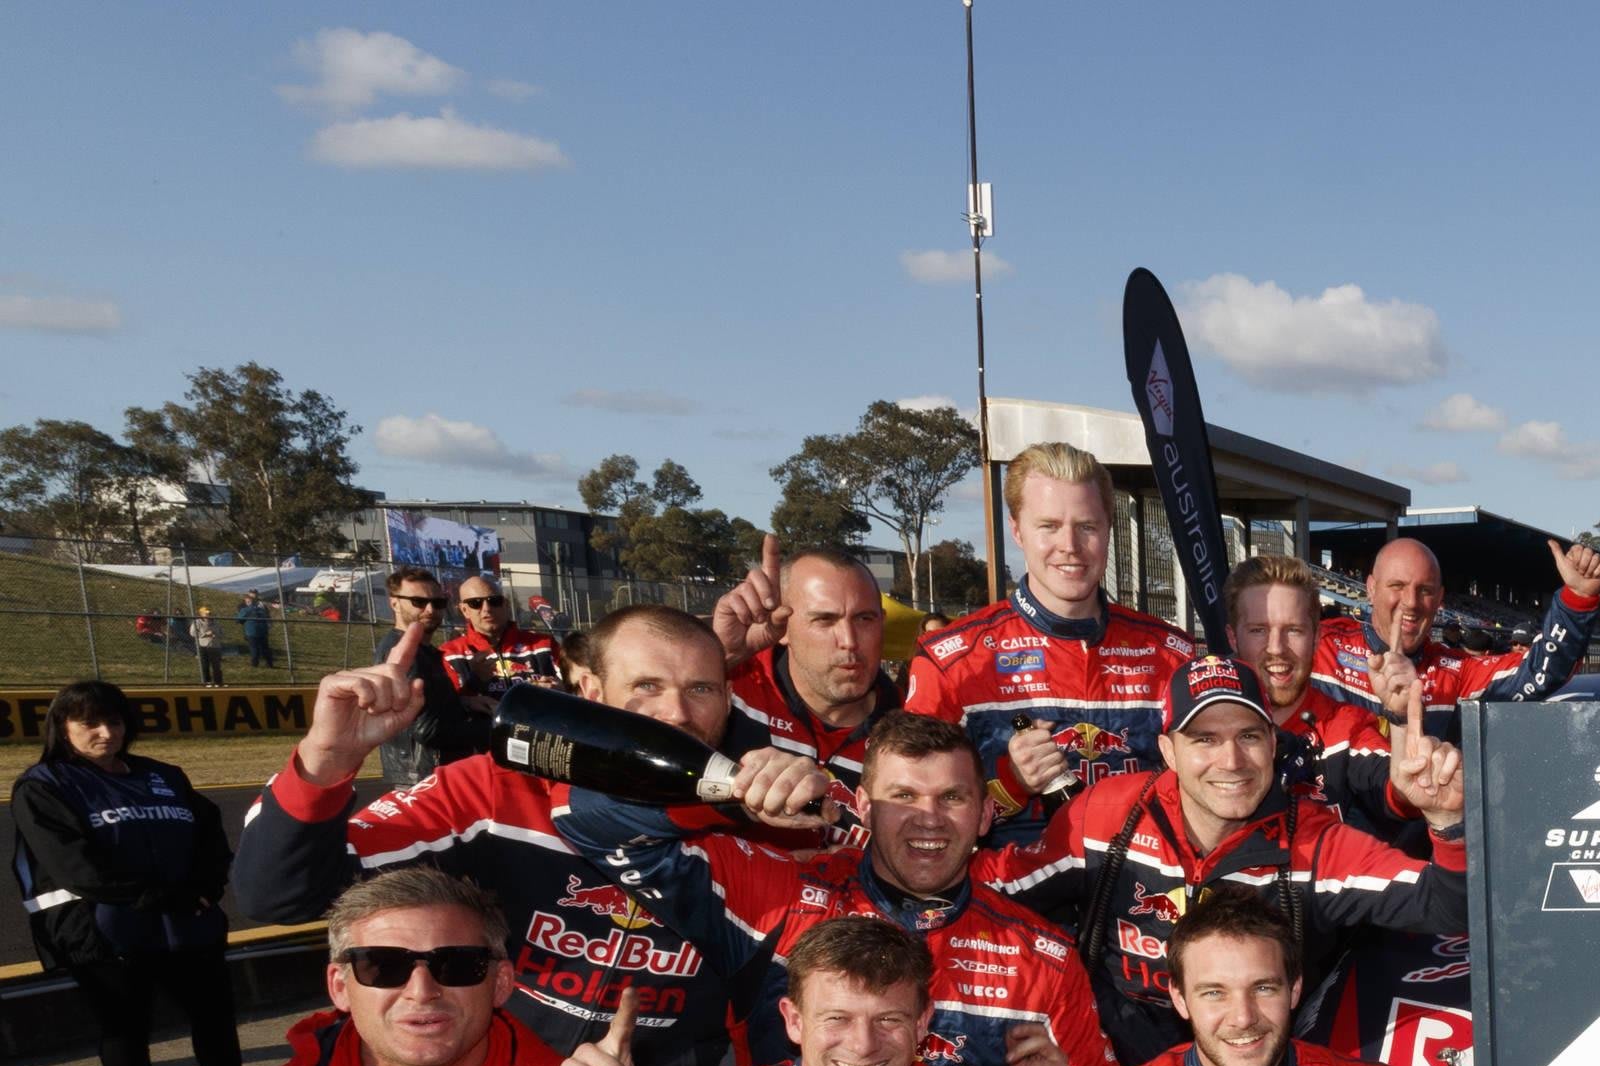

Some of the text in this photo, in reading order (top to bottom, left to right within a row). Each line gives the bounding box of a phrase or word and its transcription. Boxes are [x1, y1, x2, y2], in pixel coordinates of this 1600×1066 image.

[1164, 443, 1218, 604] australia
[934, 637, 964, 657] OMP
[1001, 635, 1050, 650] CALTEX
[1345, 644, 1374, 658] CALTE
[1017, 683, 1050, 692] STEEL
[1111, 684, 1150, 694] IVECO
[1190, 677, 1242, 696] Holden
[1132, 833, 1160, 849] ALTE
[526, 910, 703, 977] Red Bull
[950, 936, 1020, 955] GEARWRENCH
[1035, 938, 1068, 958] OMP
[948, 959, 1018, 976] XFORCE
[958, 983, 1009, 998] IVECO
